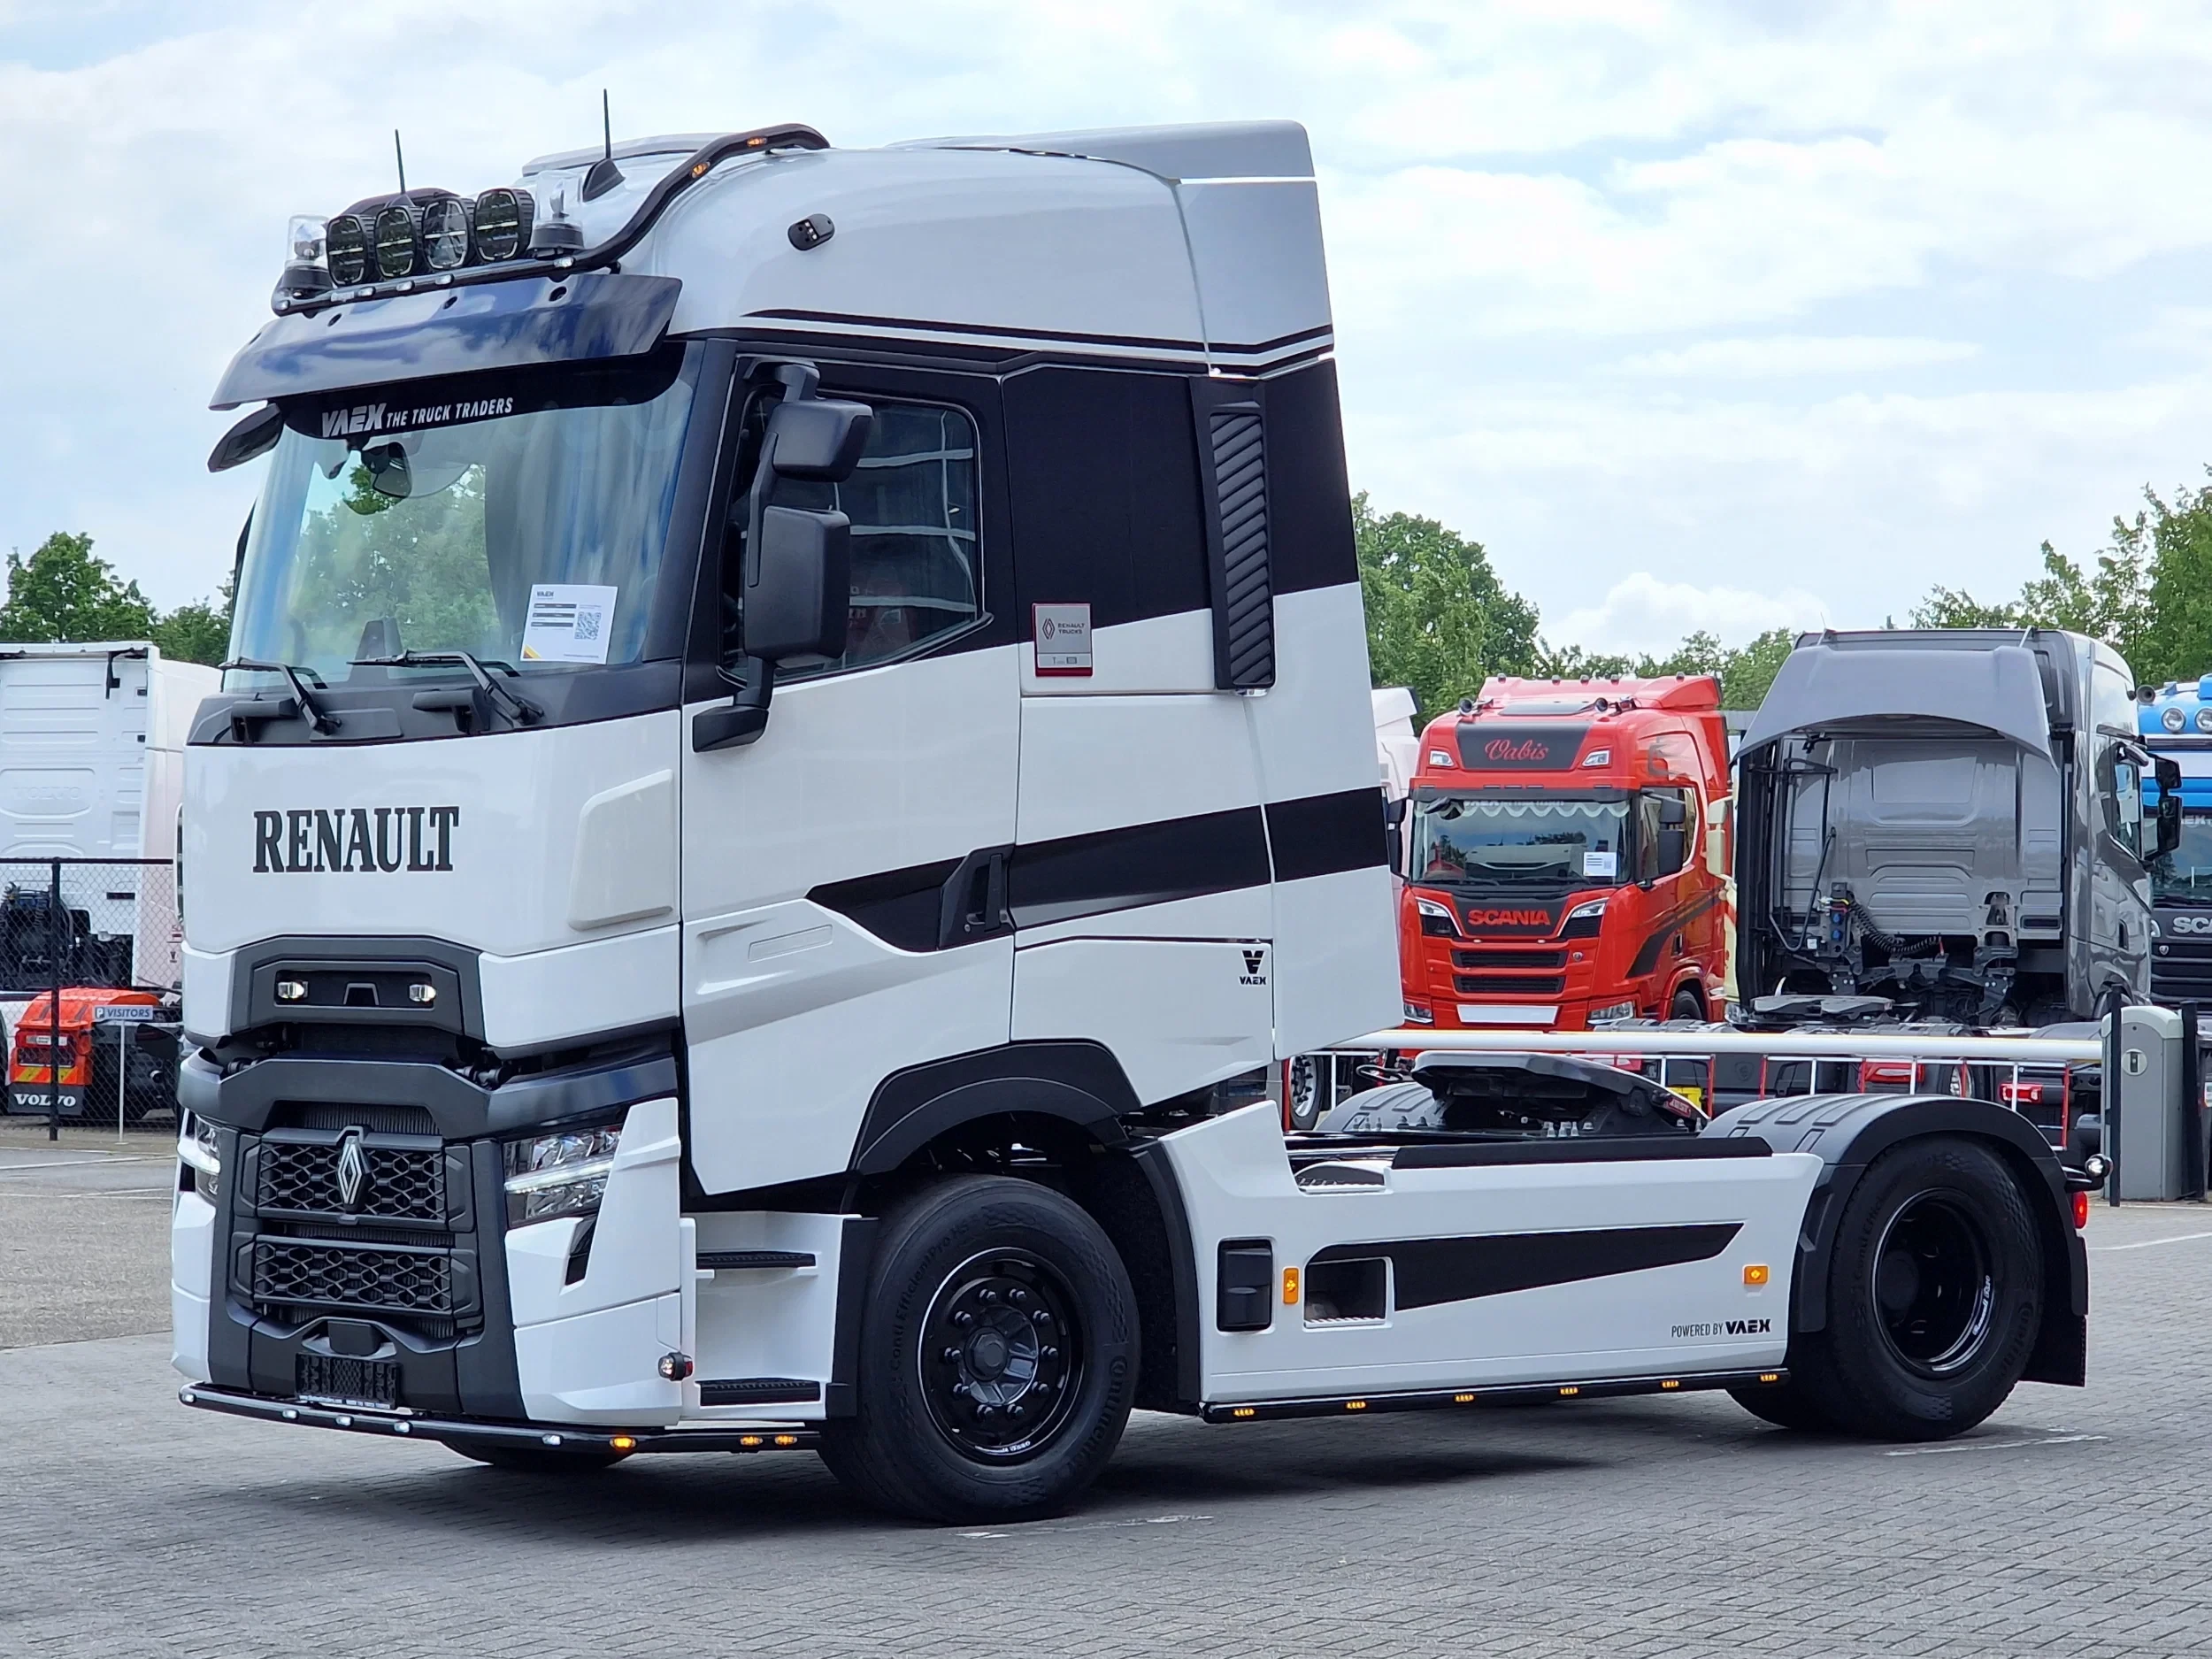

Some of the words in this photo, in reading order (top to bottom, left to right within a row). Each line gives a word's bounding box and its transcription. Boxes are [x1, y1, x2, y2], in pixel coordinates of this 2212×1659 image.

[322, 403, 387, 438] VAEX
[386, 411, 409, 428] THE
[411, 404, 451, 425] TRUCK
[456, 397, 514, 419] TRADERS
[253, 806, 459, 872] RENAULT
[1468, 910, 1550, 926] SCANIA
[2173, 917, 2212, 933] SC
[1239, 976, 1266, 985] VAEX
[107, 1009, 150, 1018] VISITORS
[1671, 1324, 1710, 1338] POWERED
[1713, 1323, 1724, 1335] BY
[1725, 1318, 1771, 1335] VAEX
